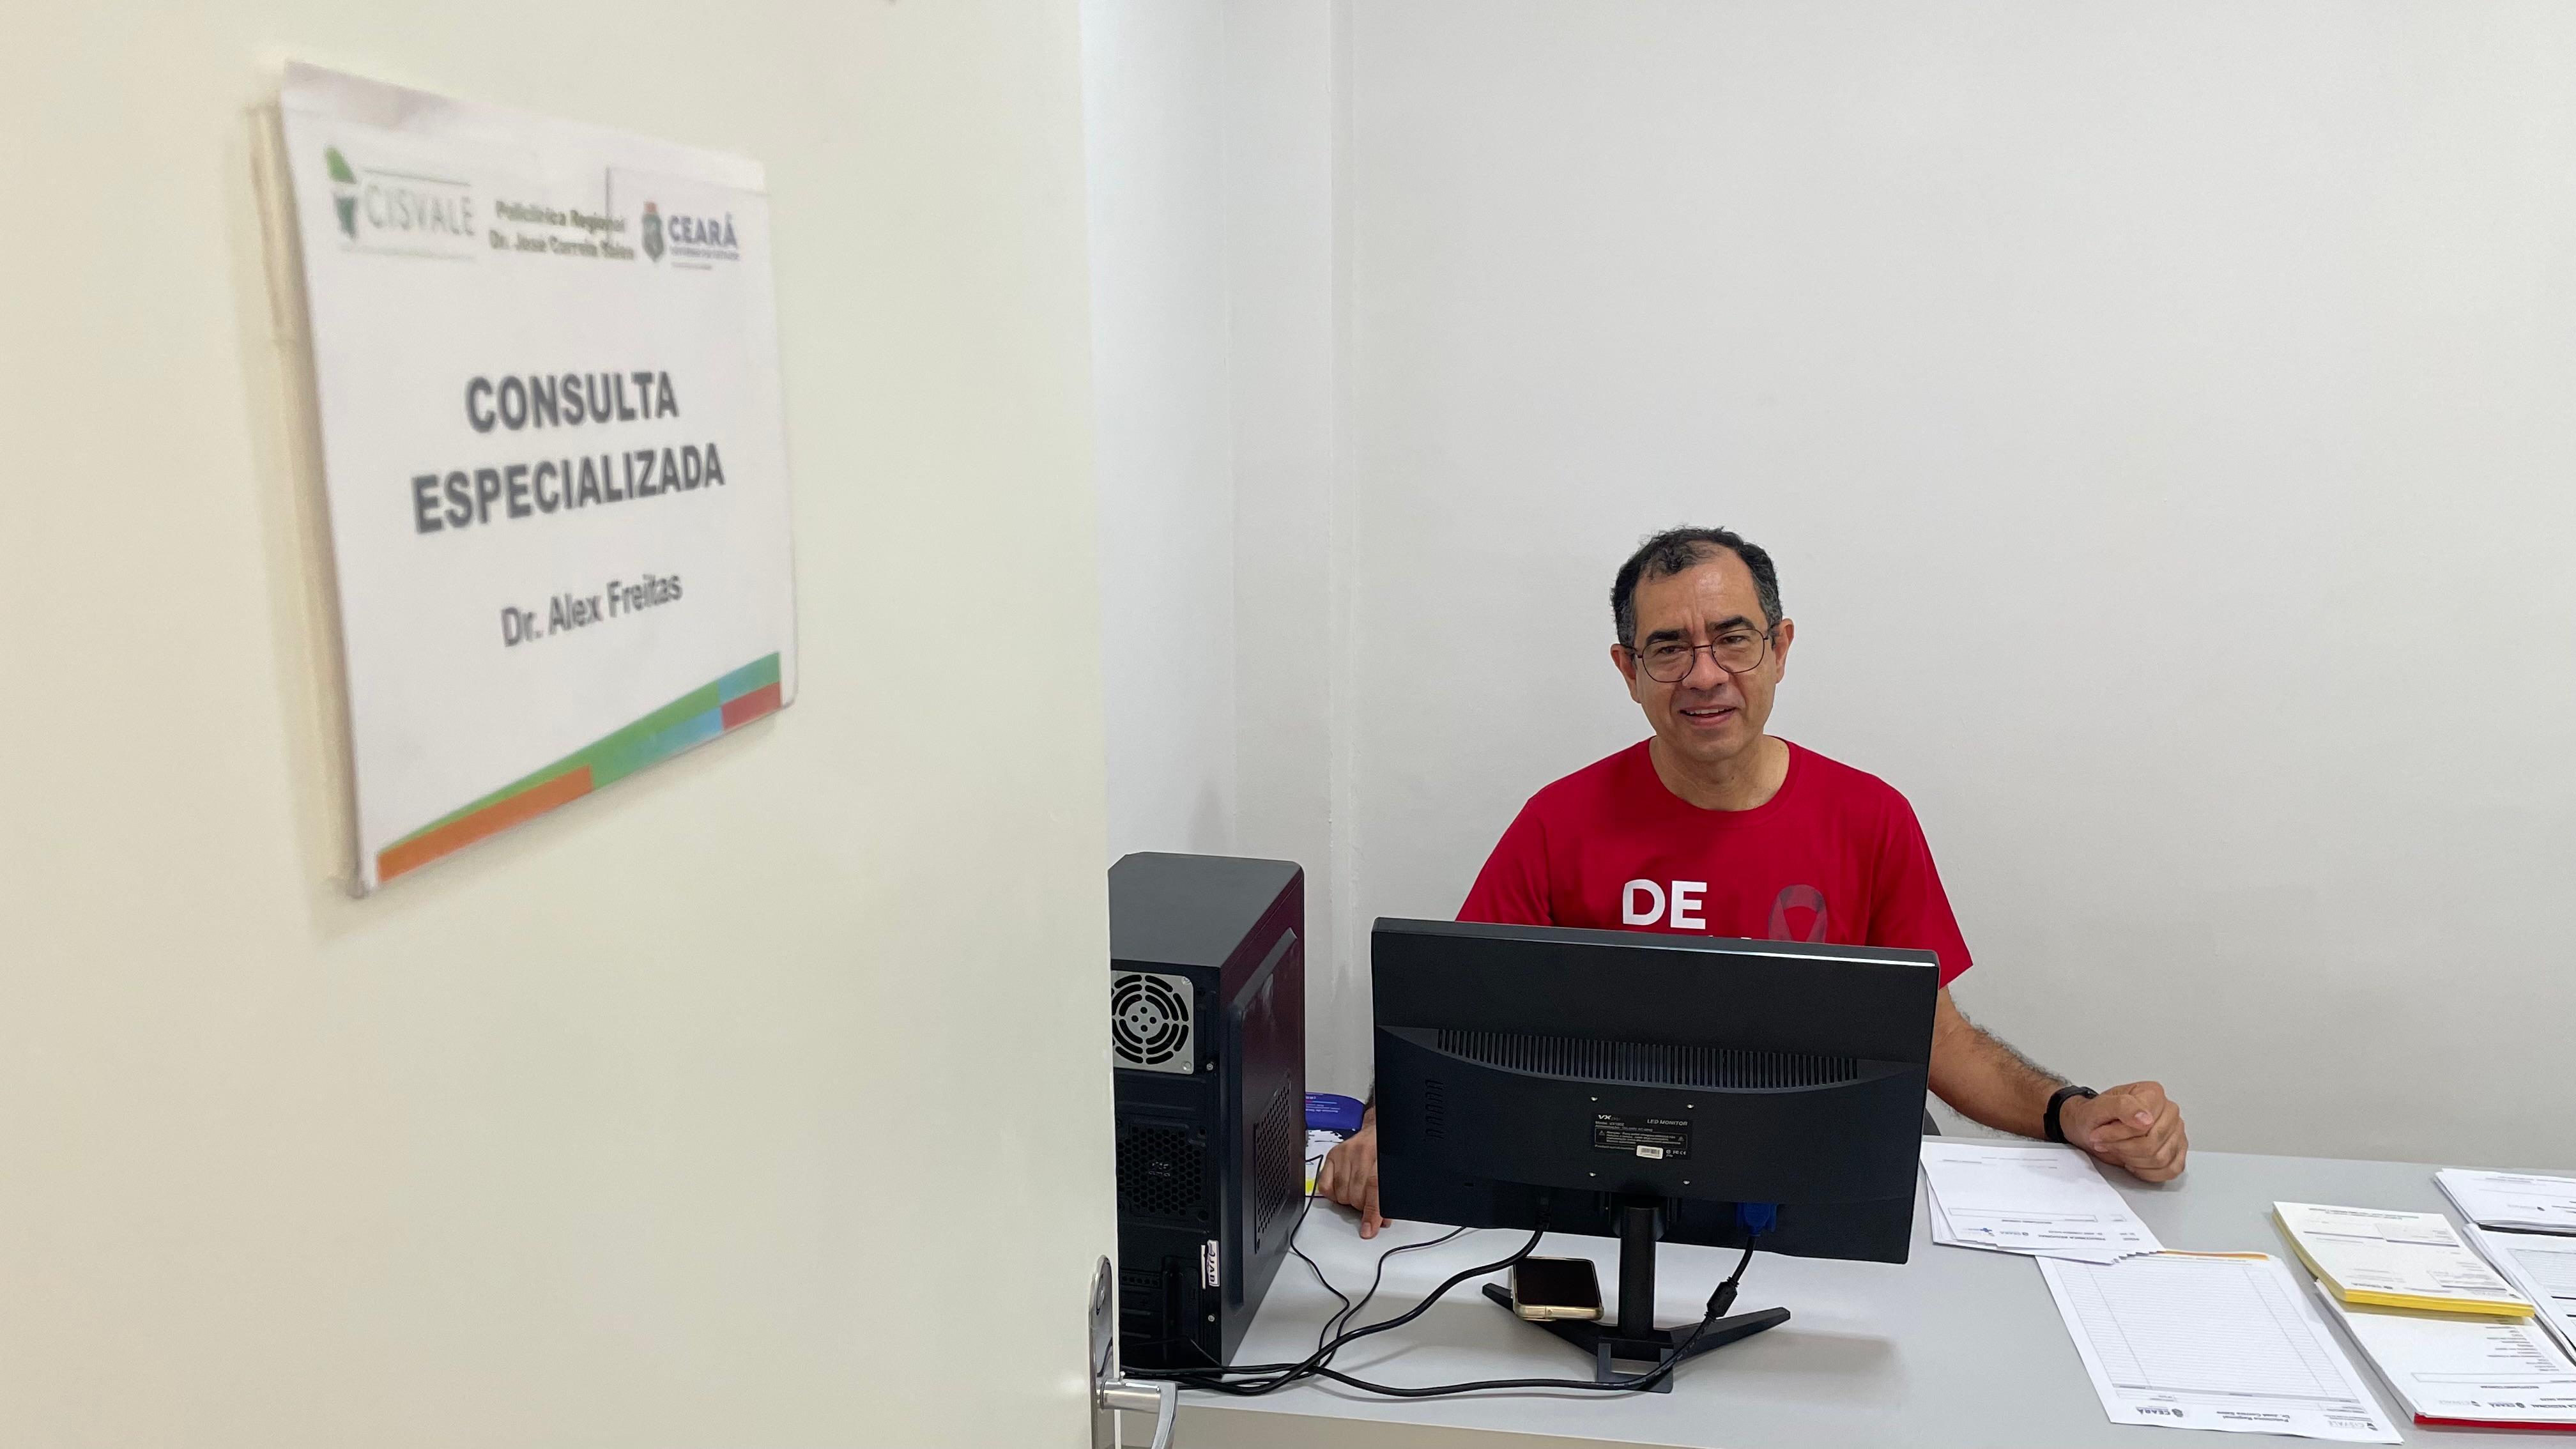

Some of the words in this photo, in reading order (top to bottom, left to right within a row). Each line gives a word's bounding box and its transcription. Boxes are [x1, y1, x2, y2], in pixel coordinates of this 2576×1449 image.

[363, 182, 476, 236] CISVALE
[668, 211, 739, 247] CEARÁ
[465, 371, 680, 434] CONSULTA
[411, 442, 726, 535] ESPECIALIZADA
[501, 606, 543, 648] Dr.
[548, 592, 604, 636] Alex
[607, 574, 684, 618] Freitas
[1623, 878, 1707, 930] DE
